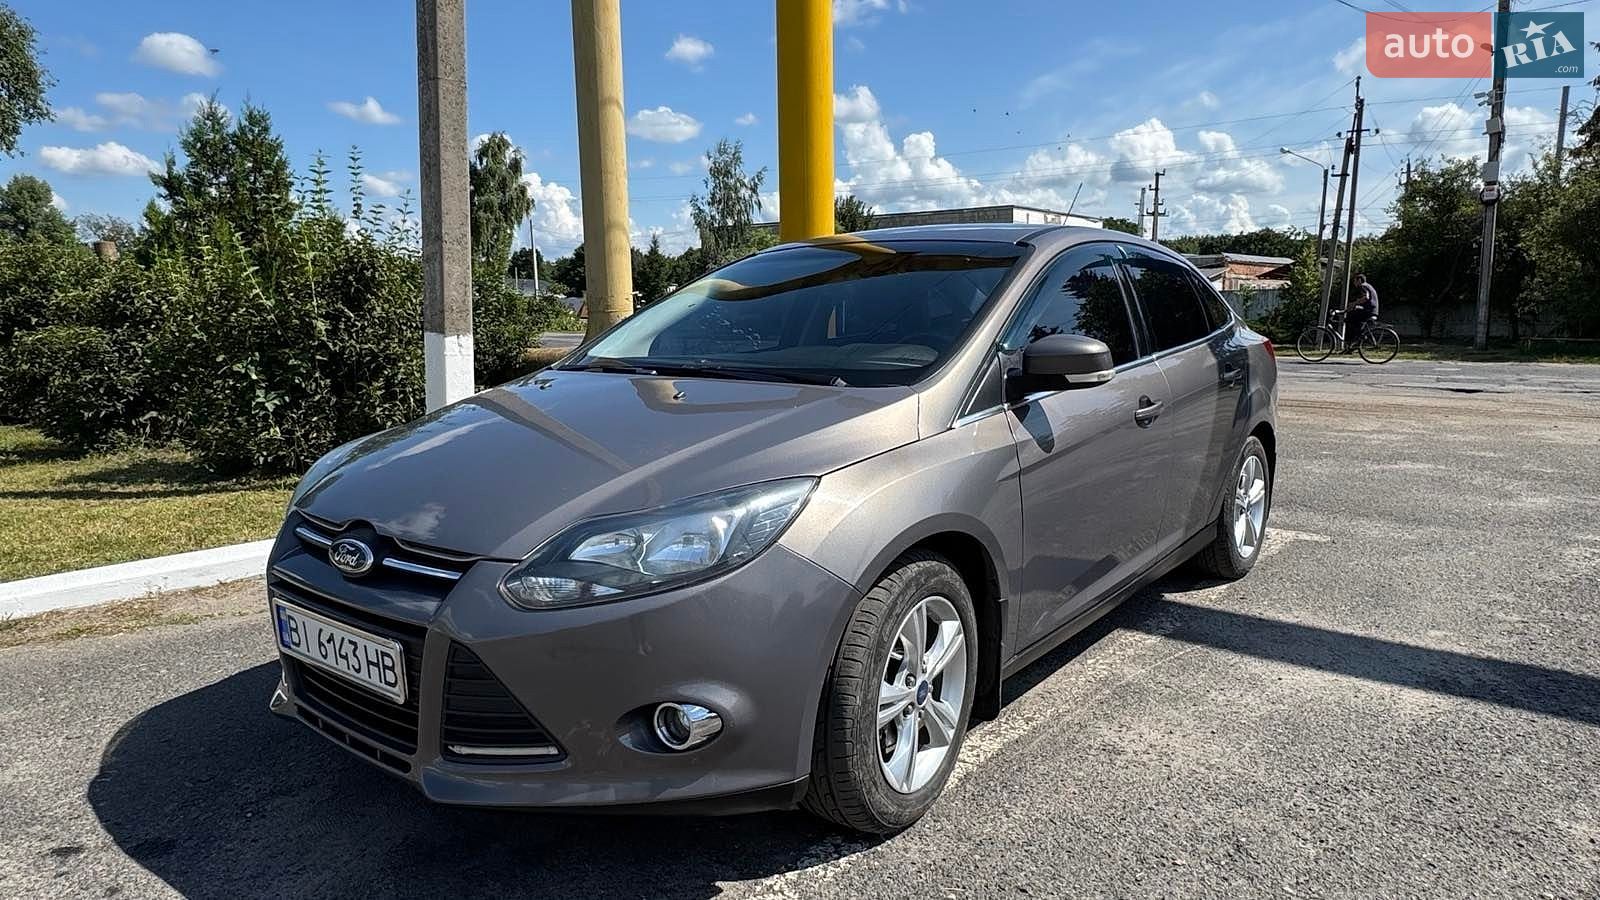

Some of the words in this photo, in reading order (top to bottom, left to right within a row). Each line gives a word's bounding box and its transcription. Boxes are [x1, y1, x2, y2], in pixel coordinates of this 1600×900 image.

[334, 543, 360, 567] Ford
[288, 614, 310, 653] BI
[318, 628, 362, 674] 6143
[364, 644, 398, 688] HB
